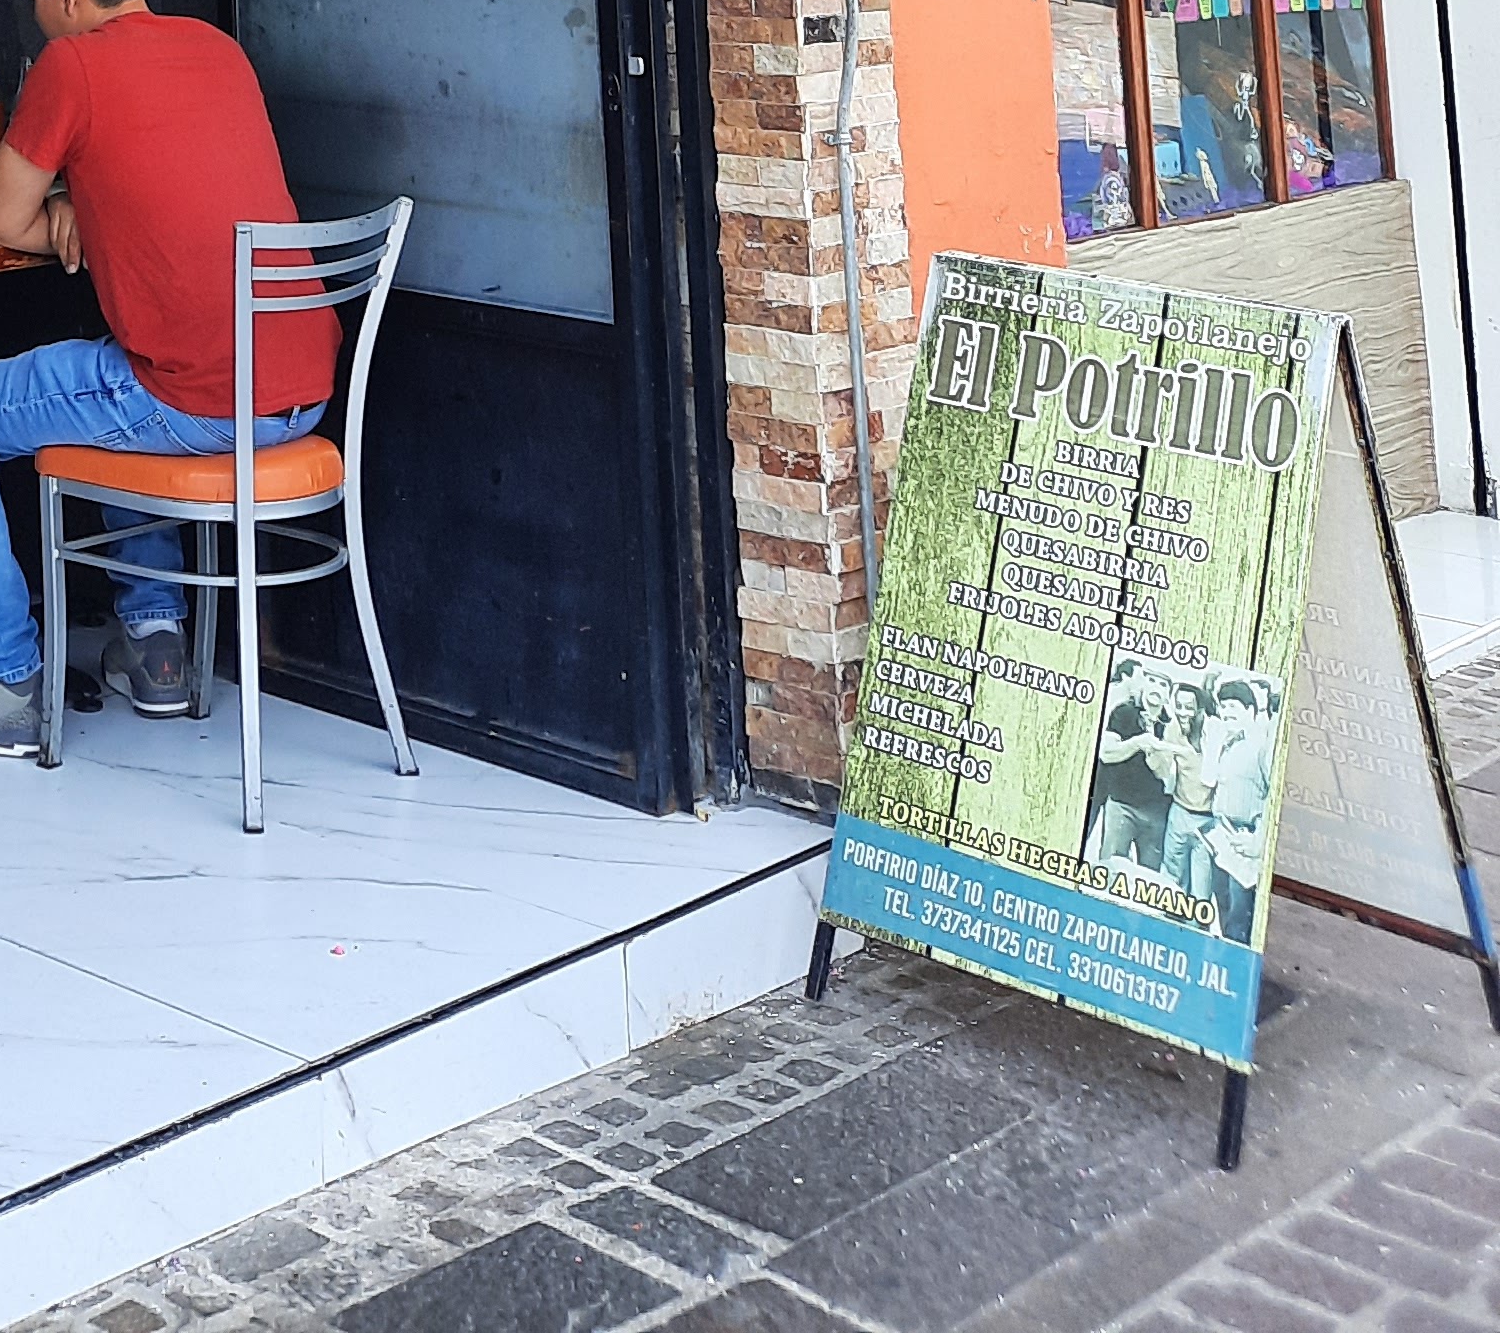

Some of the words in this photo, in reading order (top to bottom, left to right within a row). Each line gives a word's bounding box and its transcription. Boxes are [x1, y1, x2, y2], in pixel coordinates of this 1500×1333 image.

[942, 270, 1087, 324] Birrieria
[1098, 299, 1312, 365] Zapotlanejo
[927, 315, 999, 412] El
[1009, 332, 1300, 472] Potrillo
[1000, 461, 1033, 488] DE
[1037, 470, 1117, 506] CHIVO
[1122, 489, 1140, 511] Y
[1143, 493, 1192, 524] RES
[1055, 440, 1140, 479] BIRRIA
[975, 488, 1082, 532] MENUDO
[1086, 515, 1121, 542] DE
[1124, 524, 1208, 562] CHIVO
[1001, 529, 1169, 589] QUESABIRRIA
[948, 581, 1062, 631] FRIJOLES
[1064, 613, 1208, 668] ADOBADOS
[1002, 562, 1158, 621] QUESADILLA
[875, 660, 974, 706] CERVEZA
[880, 625, 938, 660] FLAN
[941, 642, 1094, 704] NAPOLITANO
[863, 726, 992, 784] REFRESCOS
[869, 692, 1004, 752] MICHELADA
[879, 795, 1006, 858] TORTILLAS
[1007, 838, 1107, 891] HECHAS
[1109, 873, 1130, 898] A
[1134, 879, 1216, 925] MANO
[843, 837, 918, 884] PORFIRIO
[921, 862, 961, 899] DÍAZ
[963, 879, 987, 912] 10,
[991, 889, 1060, 934] CENTRO
[1062, 913, 1192, 983] ZAPOTLANEJO,
[1196, 960, 1238, 998] JAL.
[883, 886, 916, 920] TEL.
[921, 899, 1021, 957] 3737341125
[1024, 938, 1062, 974] CEL.
[1067, 952, 1181, 1014] 3310613137
